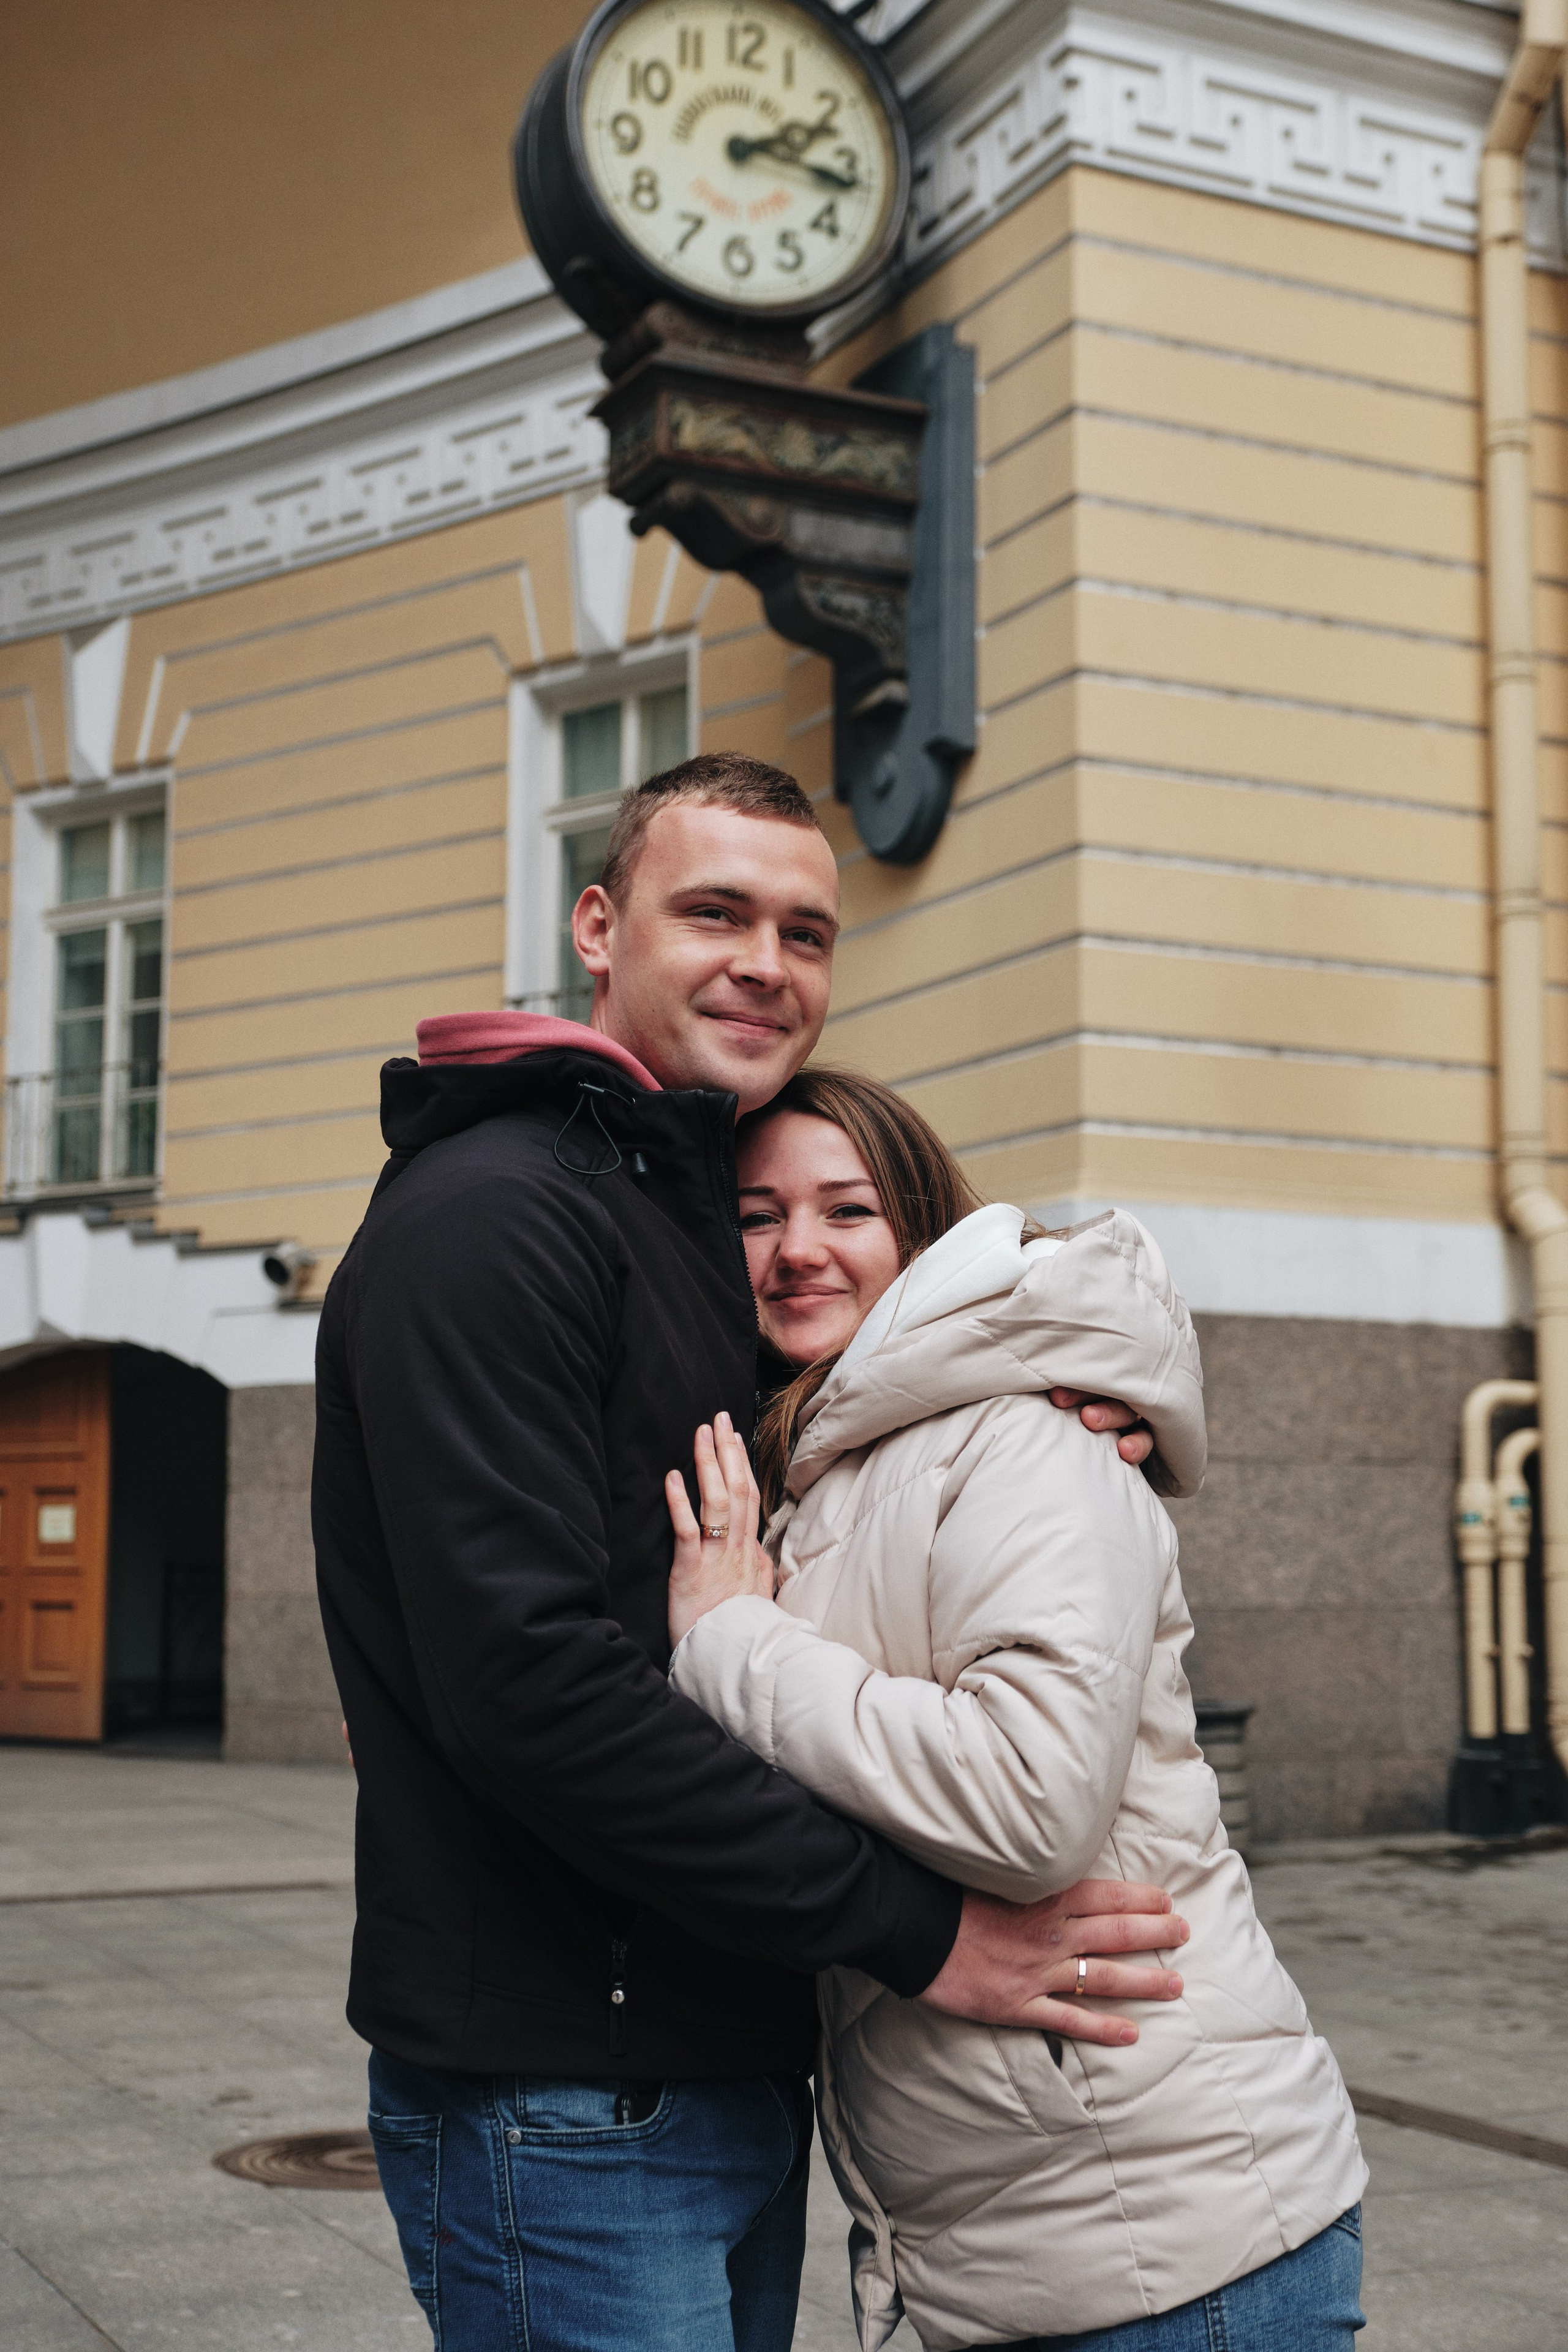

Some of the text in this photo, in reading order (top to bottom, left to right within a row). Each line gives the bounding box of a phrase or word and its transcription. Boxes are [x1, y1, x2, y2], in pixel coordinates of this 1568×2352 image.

[677, 28, 704, 72] 11
[727, 22, 767, 72] 12
[783, 47, 795, 89] 1
[628, 59, 673, 104] 10
[612, 113, 643, 155] 9
[815, 89, 840, 138] 2
[630, 167, 660, 213] 8
[677, 211, 705, 253] 7
[810, 199, 839, 239] 4
[723, 235, 754, 278] 6
[777, 230, 803, 273] 5
